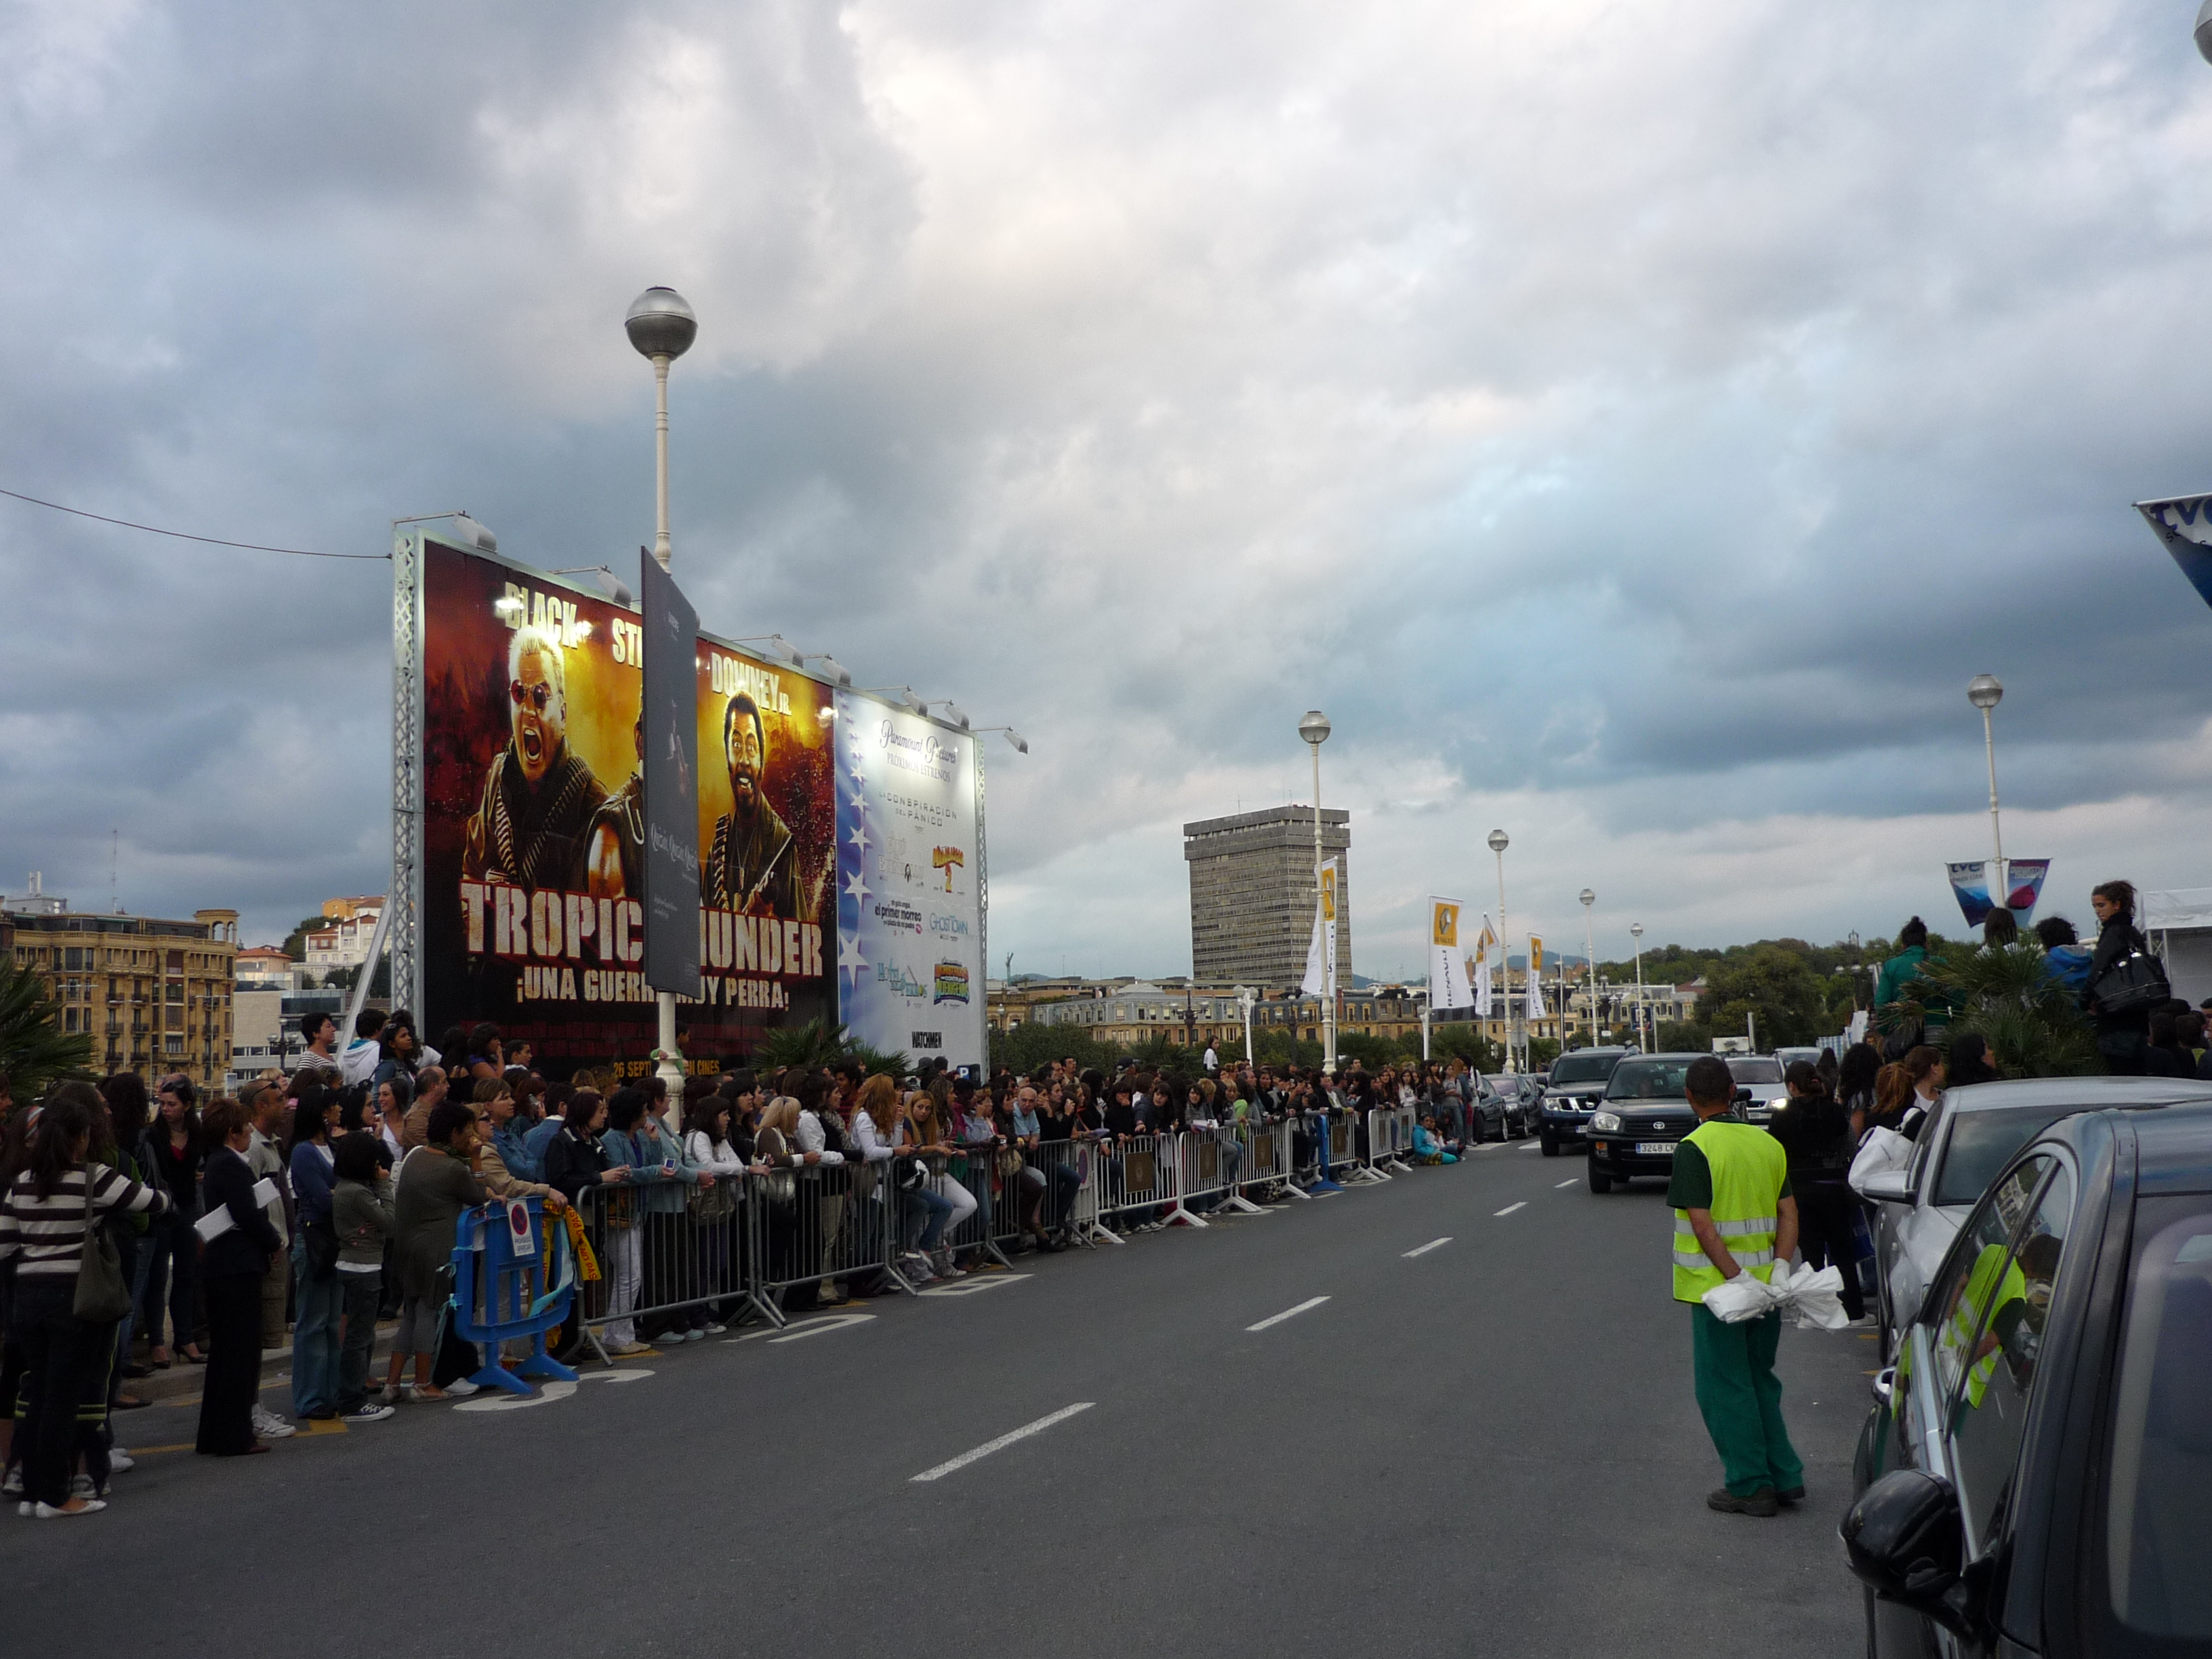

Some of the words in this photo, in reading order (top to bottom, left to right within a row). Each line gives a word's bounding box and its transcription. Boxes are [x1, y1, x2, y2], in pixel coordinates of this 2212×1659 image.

[504, 581, 578, 649] BLACK
[712, 652, 781, 712] DOWNEY
[880, 719, 924, 754] Paramount
[921, 764, 950, 783] ESTRENOS
[459, 881, 644, 962] TROPIC
[699, 909, 823, 977] UNDER
[583, 969, 659, 1003] GUERR
[912, 1031, 942, 1048] WATCHMEN
[613, 1062, 624, 1078] 26
[697, 1059, 720, 1076] CINES
[960, 1067, 969, 1078] P
[1665, 1144, 1676, 1152] CK
[579, 1247, 590, 1261] NO
[586, 1261, 598, 1280] PAS
